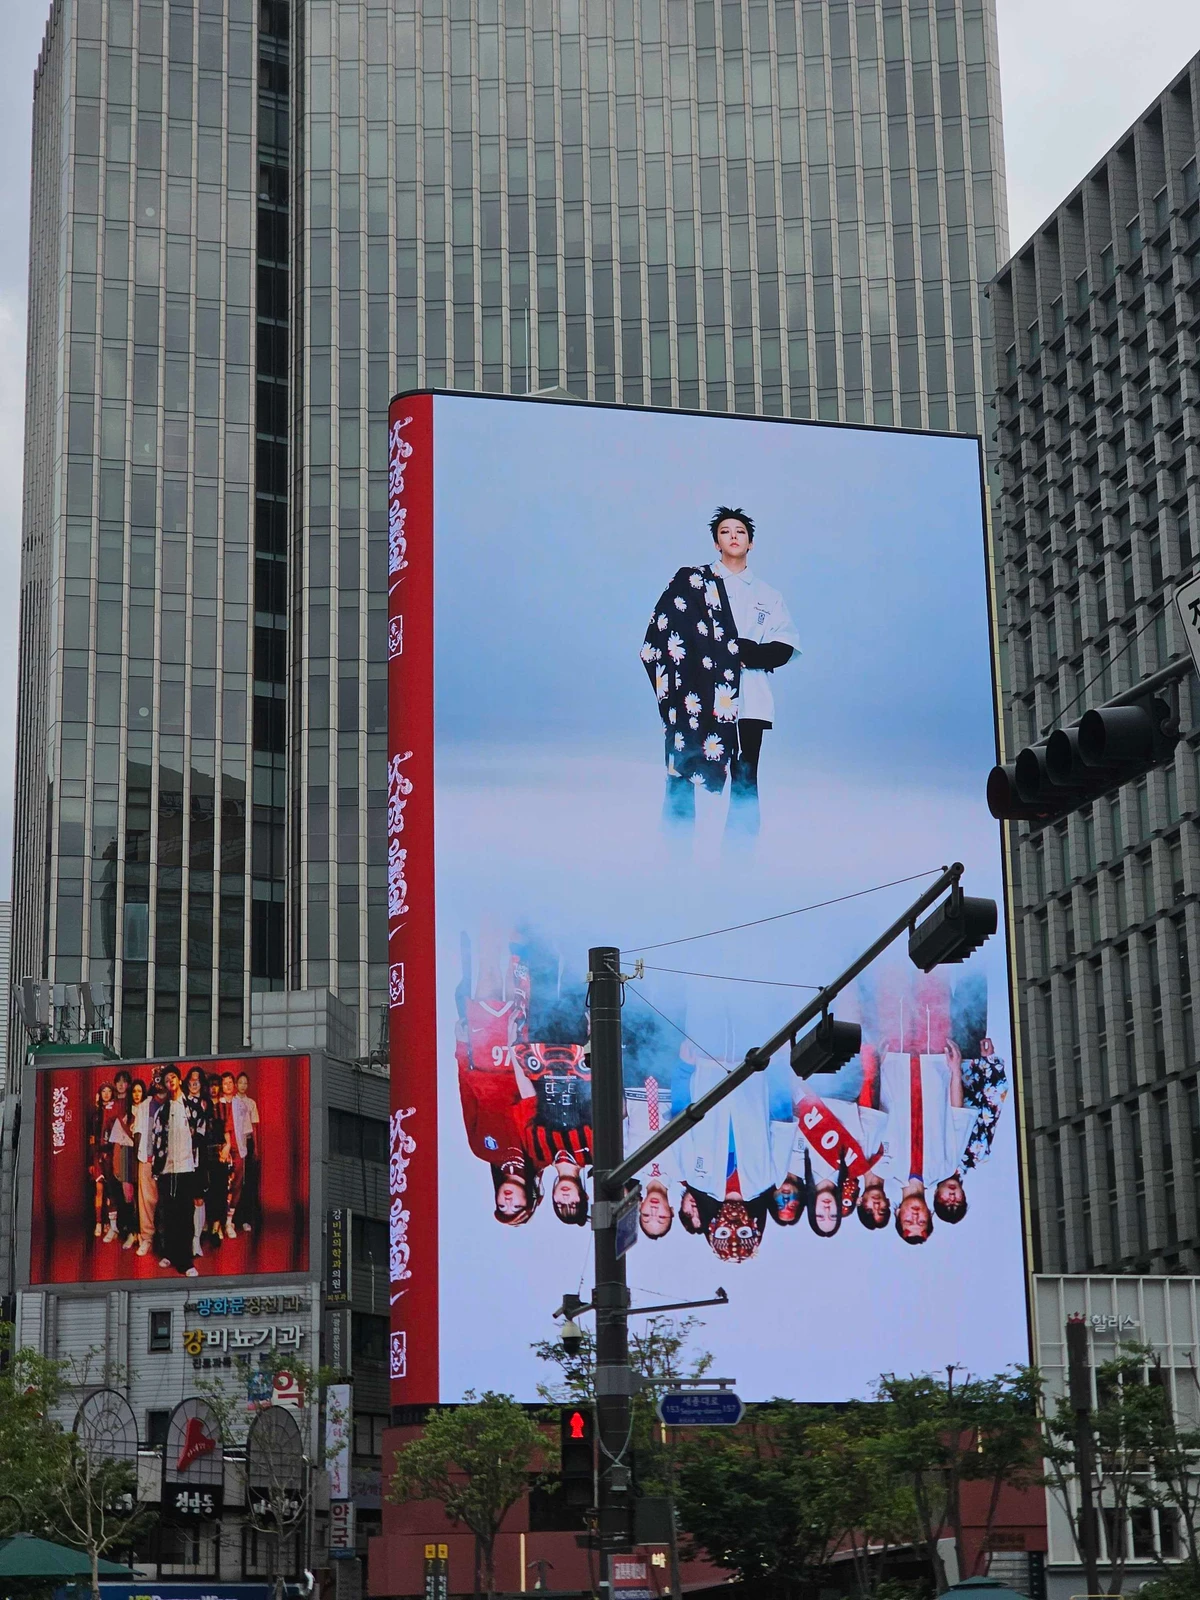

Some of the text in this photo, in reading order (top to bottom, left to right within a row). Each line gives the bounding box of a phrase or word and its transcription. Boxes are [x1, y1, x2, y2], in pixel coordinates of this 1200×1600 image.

[332, 1209, 342, 1289] 강비뇨의학과의원
[1091, 1315, 1136, 1332] 할리스
[183, 1325, 304, 1355] 강비뇨기과
[666, 1405, 680, 1413] 153
[723, 1404, 736, 1413] 157
[682, 1396, 719, 1406] 세종대로
[175, 1491, 215, 1514] 청담동
[332, 1504, 349, 1547] 약국
